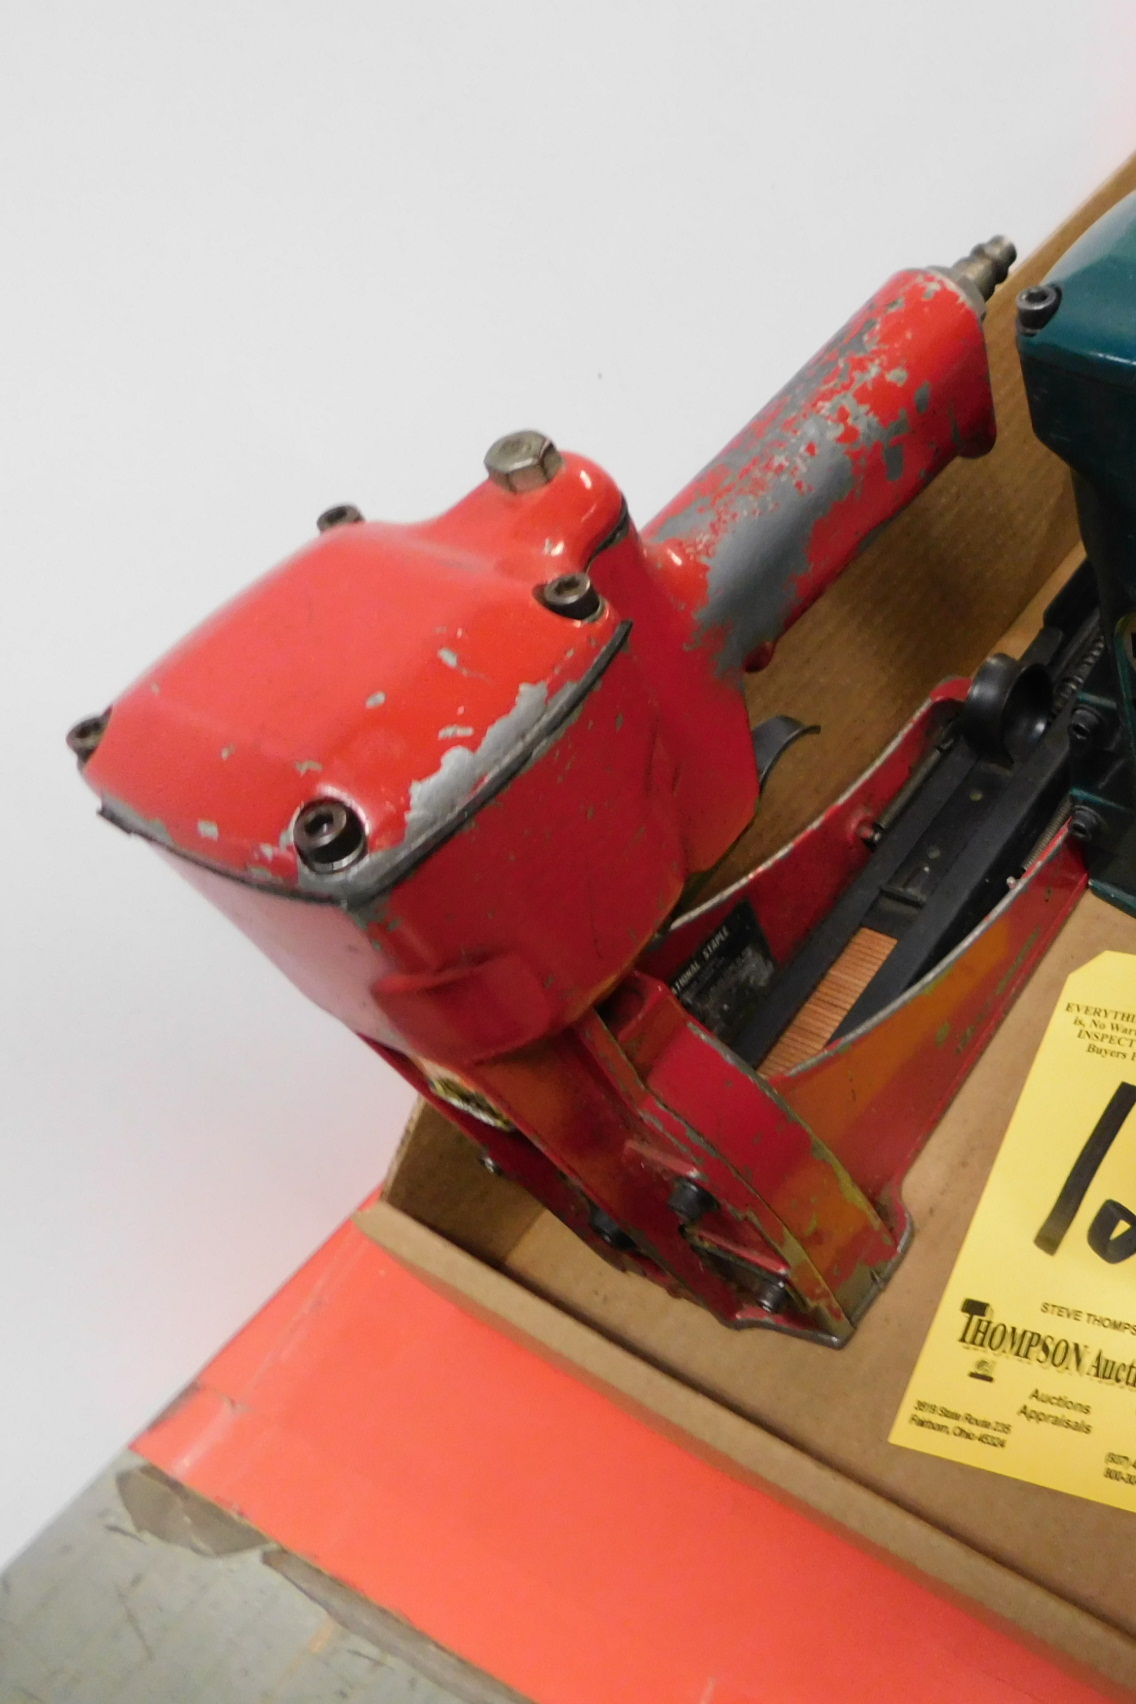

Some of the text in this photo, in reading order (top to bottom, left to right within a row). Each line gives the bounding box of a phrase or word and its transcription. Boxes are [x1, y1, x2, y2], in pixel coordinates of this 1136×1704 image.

[702, 925, 729, 960] STAPLE
[1089, 1018, 1106, 1030] No
[1085, 1043, 1127, 1060] Buyers
[1040, 1302, 1083, 1322] STEVE
[958, 1298, 1090, 1376] THOMPSON
[1029, 1388, 1092, 1415] Auctions
[1017, 1404, 1093, 1435] Appraisals
